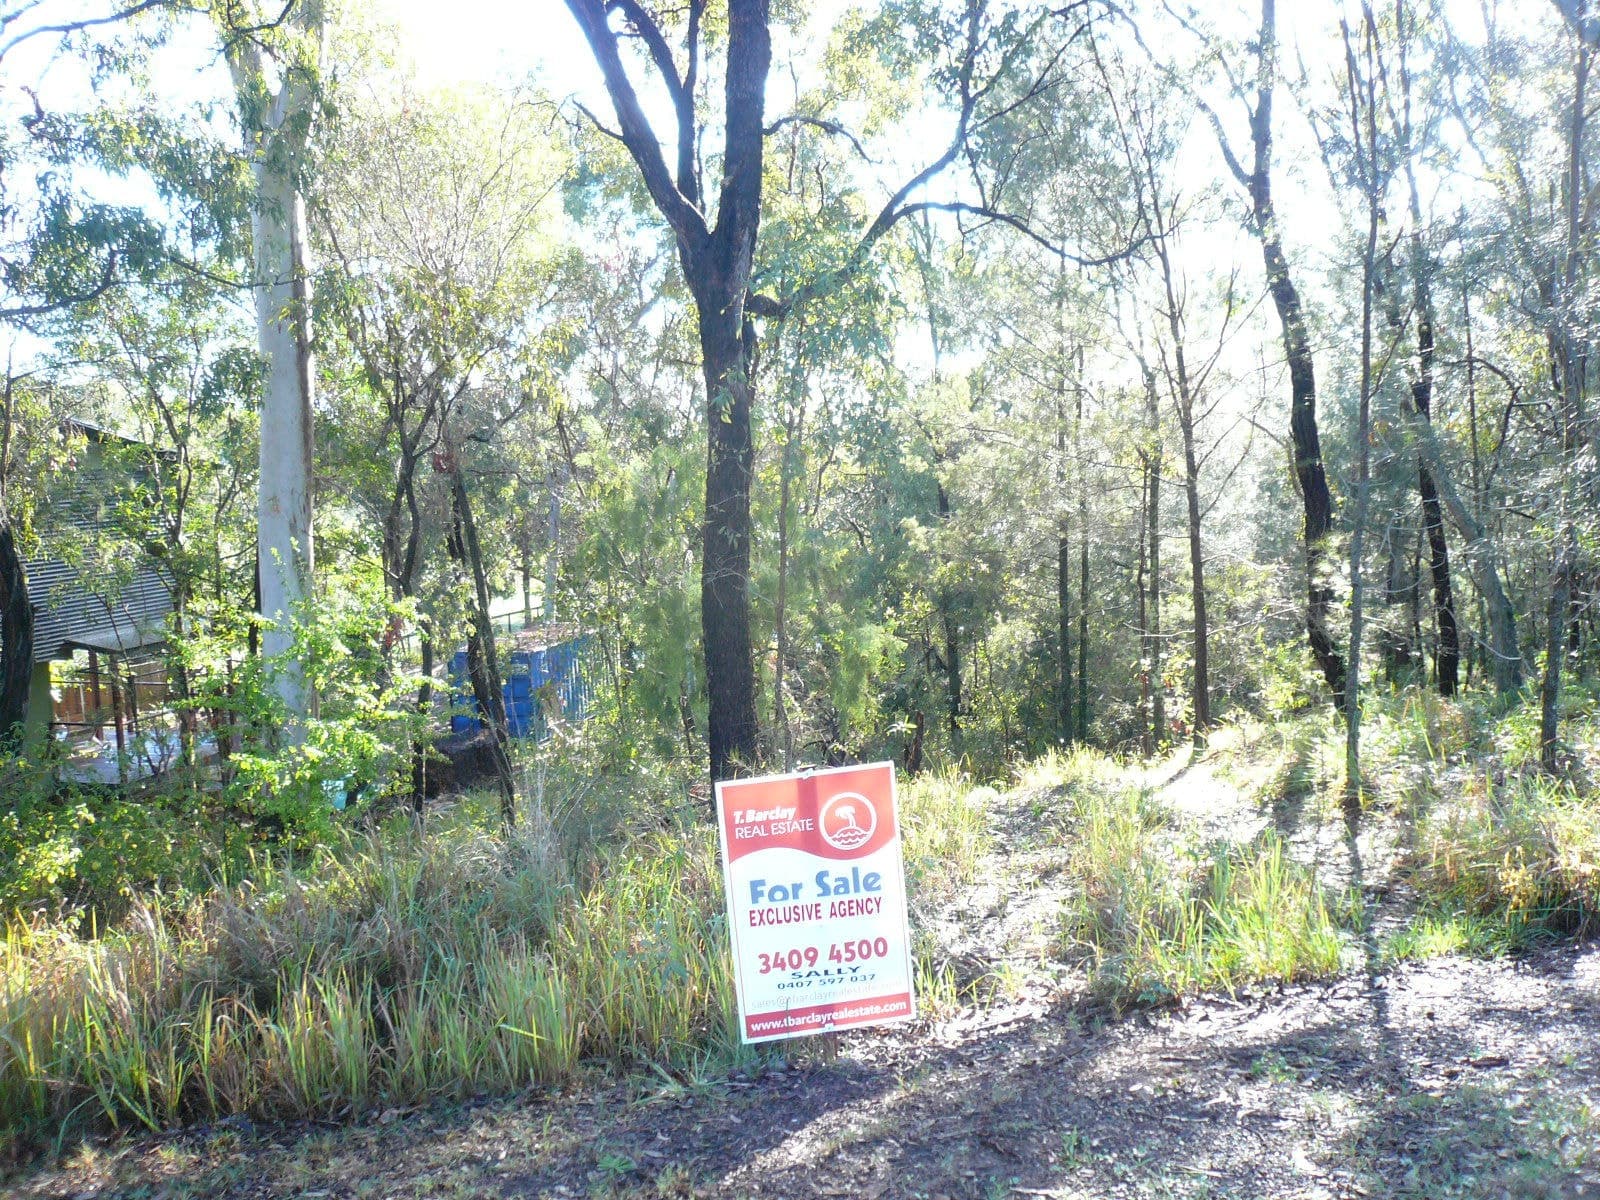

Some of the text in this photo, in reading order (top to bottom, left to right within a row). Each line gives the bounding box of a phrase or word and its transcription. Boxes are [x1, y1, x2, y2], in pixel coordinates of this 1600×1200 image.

[735, 818, 815, 840] REAL ESTATE
[749, 866, 882, 904] For Sale
[749, 896, 882, 927] EXCLUSIVE AGENCY
[758, 936, 888, 974] 3409 4500
[777, 980, 812, 990] 0407
[850, 973, 876, 983] 037
[791, 966, 862, 980] SALLY
[751, 1001, 907, 1032] www.tbarclayrealestate.com
